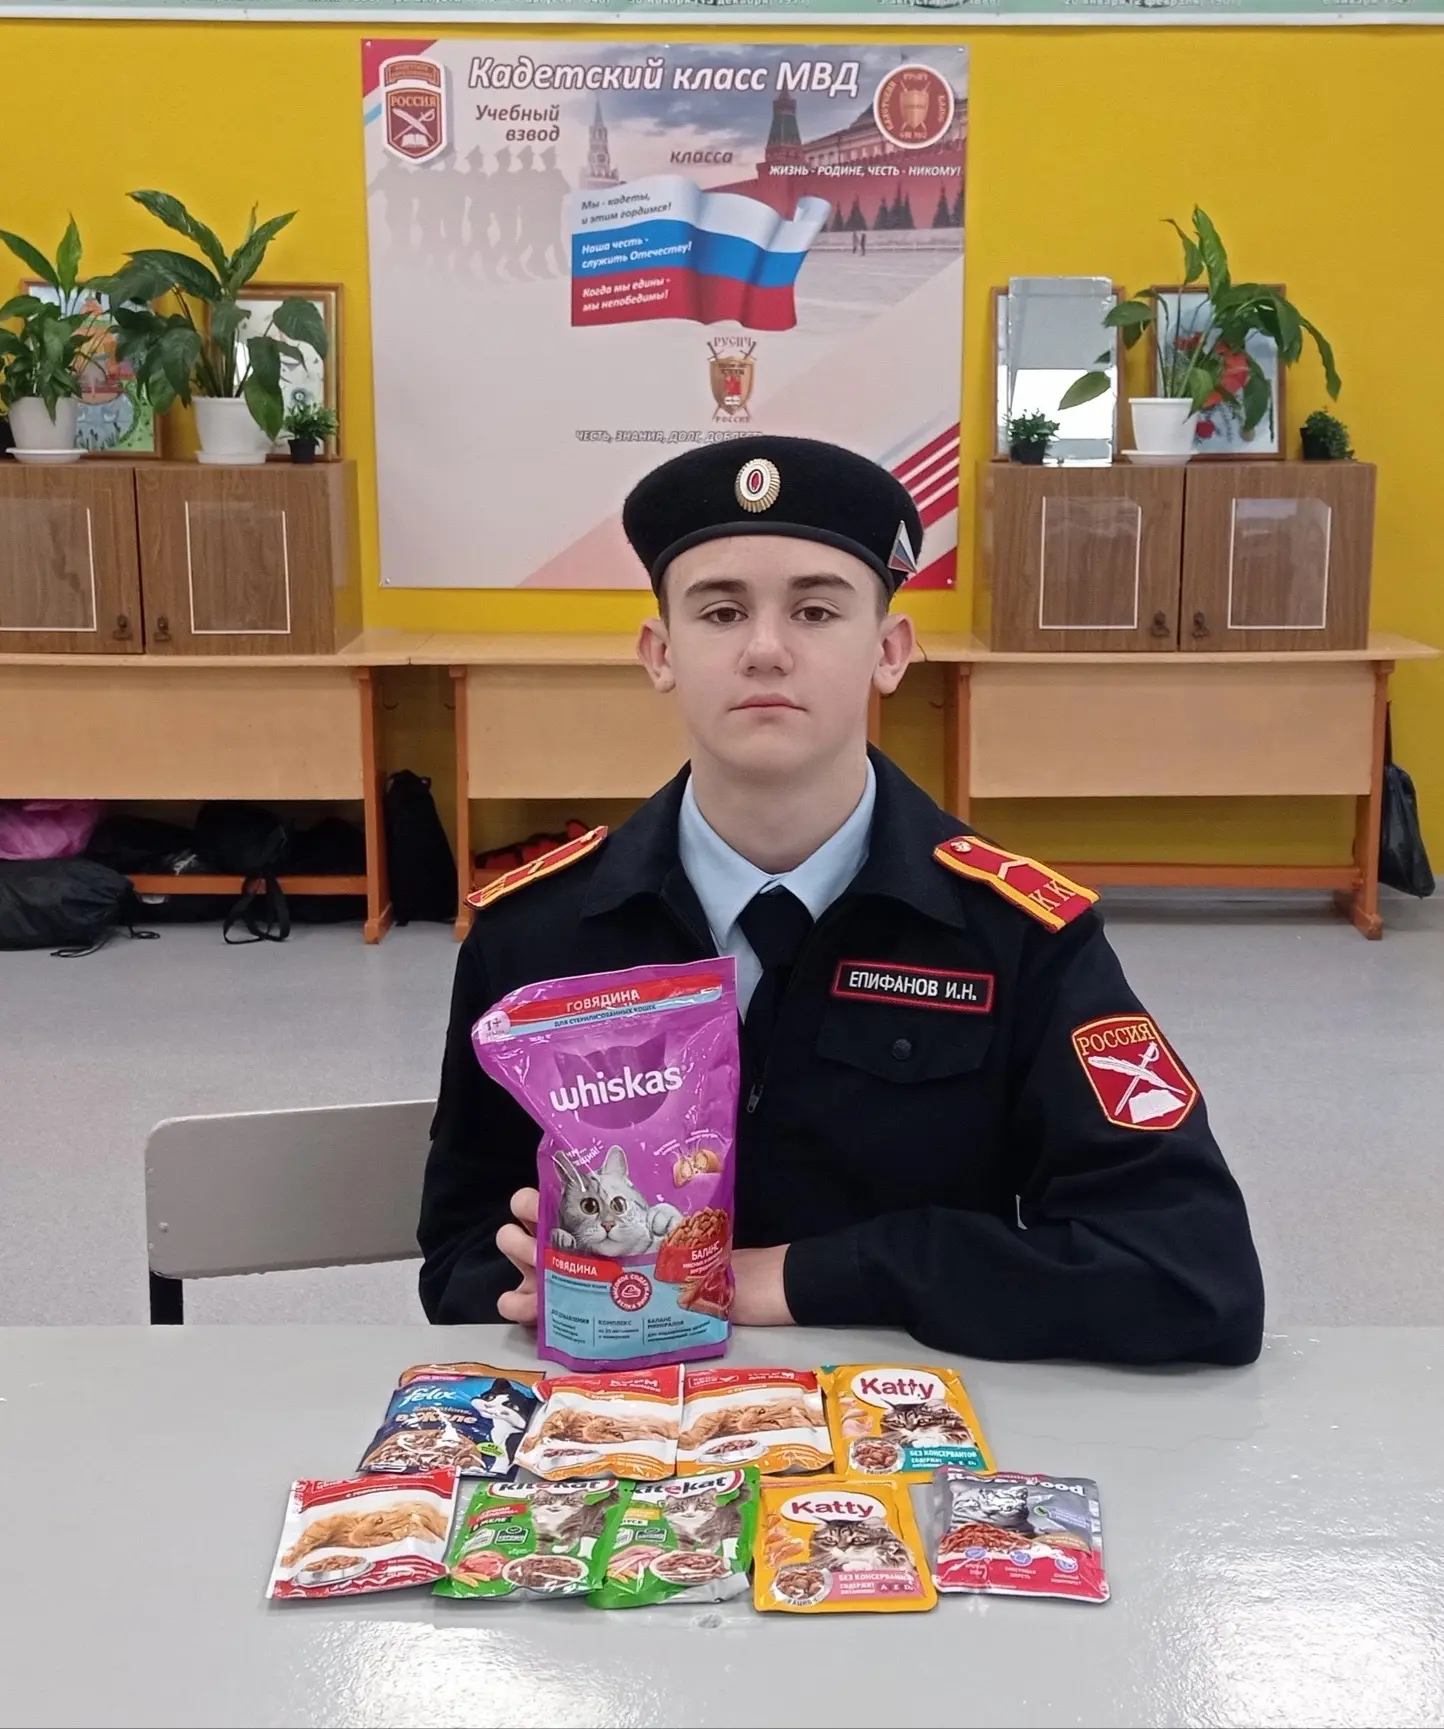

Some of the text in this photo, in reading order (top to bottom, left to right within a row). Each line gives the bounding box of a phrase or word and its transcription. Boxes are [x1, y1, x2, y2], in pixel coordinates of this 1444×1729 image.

[468, 56, 664, 91] Кадетский
[672, 66, 768, 91] класс
[776, 61, 860, 98] МВД
[391, 95, 437, 107] РОССИЯ
[475, 103, 560, 122] Учебный
[505, 125, 561, 142] взвод
[669, 150, 733, 164] класса
[769, 165, 810, 176] ЖИЗНЬ
[817, 166, 865, 178] РОДИНЕ,
[867, 166, 900, 177] ЧЕСТЬ
[908, 167, 961, 177] НИКОМУ!
[581, 200, 600, 210] Мы
[590, 212, 618, 223] этим
[620, 202, 672, 219] гордимся!
[581, 243, 611, 255] Наша
[612, 238, 643, 250] честь
[581, 241, 693, 269] служить Отечеству!
[582, 285, 612, 298] Когда
[613, 283, 631, 293] мы
[632, 278, 665, 290] едины
[582, 289, 669, 312] мы непобедимы!
[849, 971, 977, 1001] ЕПИФАНОВ И.Н.
[566, 989, 640, 1013] ГОВЯДИНА
[1076, 1023, 1156, 1057] РОССИЯ
[550, 1066, 683, 1113] whiskas
[552, 1256, 598, 1276] ГОВЯДИНА
[860, 1376, 934, 1400] Katty
[791, 1500, 874, 1520] Katty
